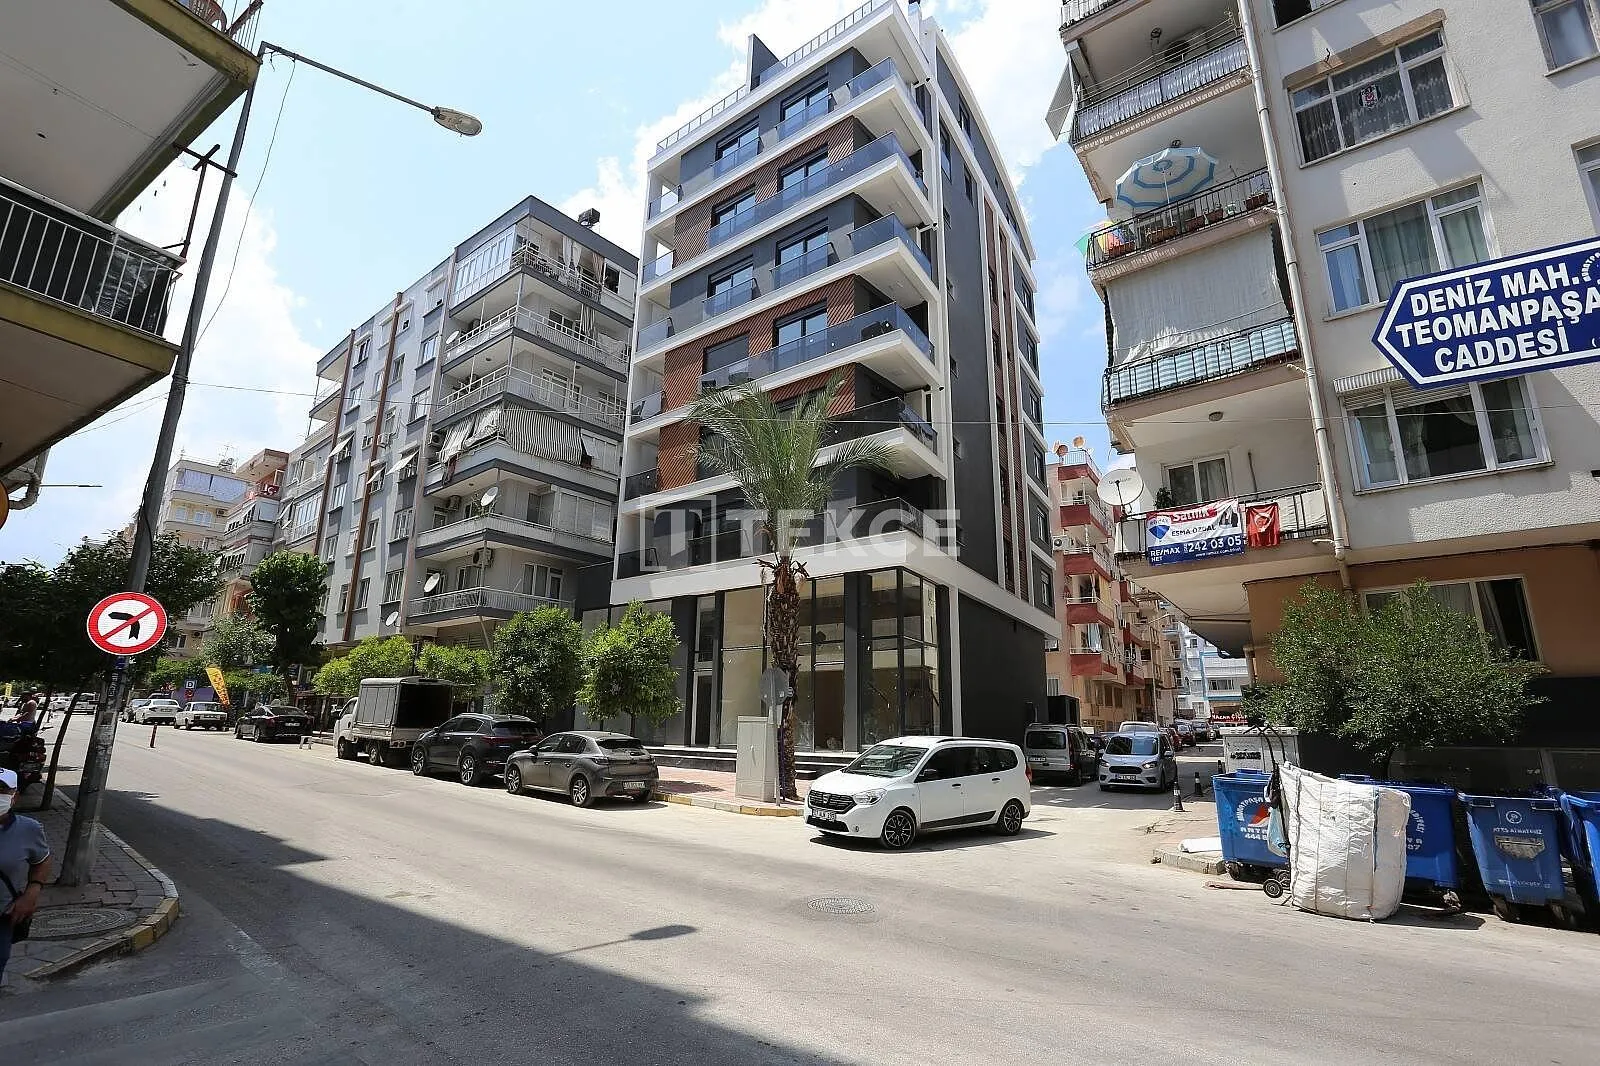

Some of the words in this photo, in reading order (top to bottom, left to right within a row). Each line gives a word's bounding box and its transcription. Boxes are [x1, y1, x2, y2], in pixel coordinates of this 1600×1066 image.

[1410, 277, 1495, 317] DENİZ
[1501, 263, 1580, 299] MAH.
[1395, 287, 1600, 348] TEOMANPAŞA
[1434, 320, 1569, 373] CADDESİ
[1188, 541, 1208, 553] 242
[1210, 538, 1224, 549] 03
[1227, 536, 1242, 546] 05
